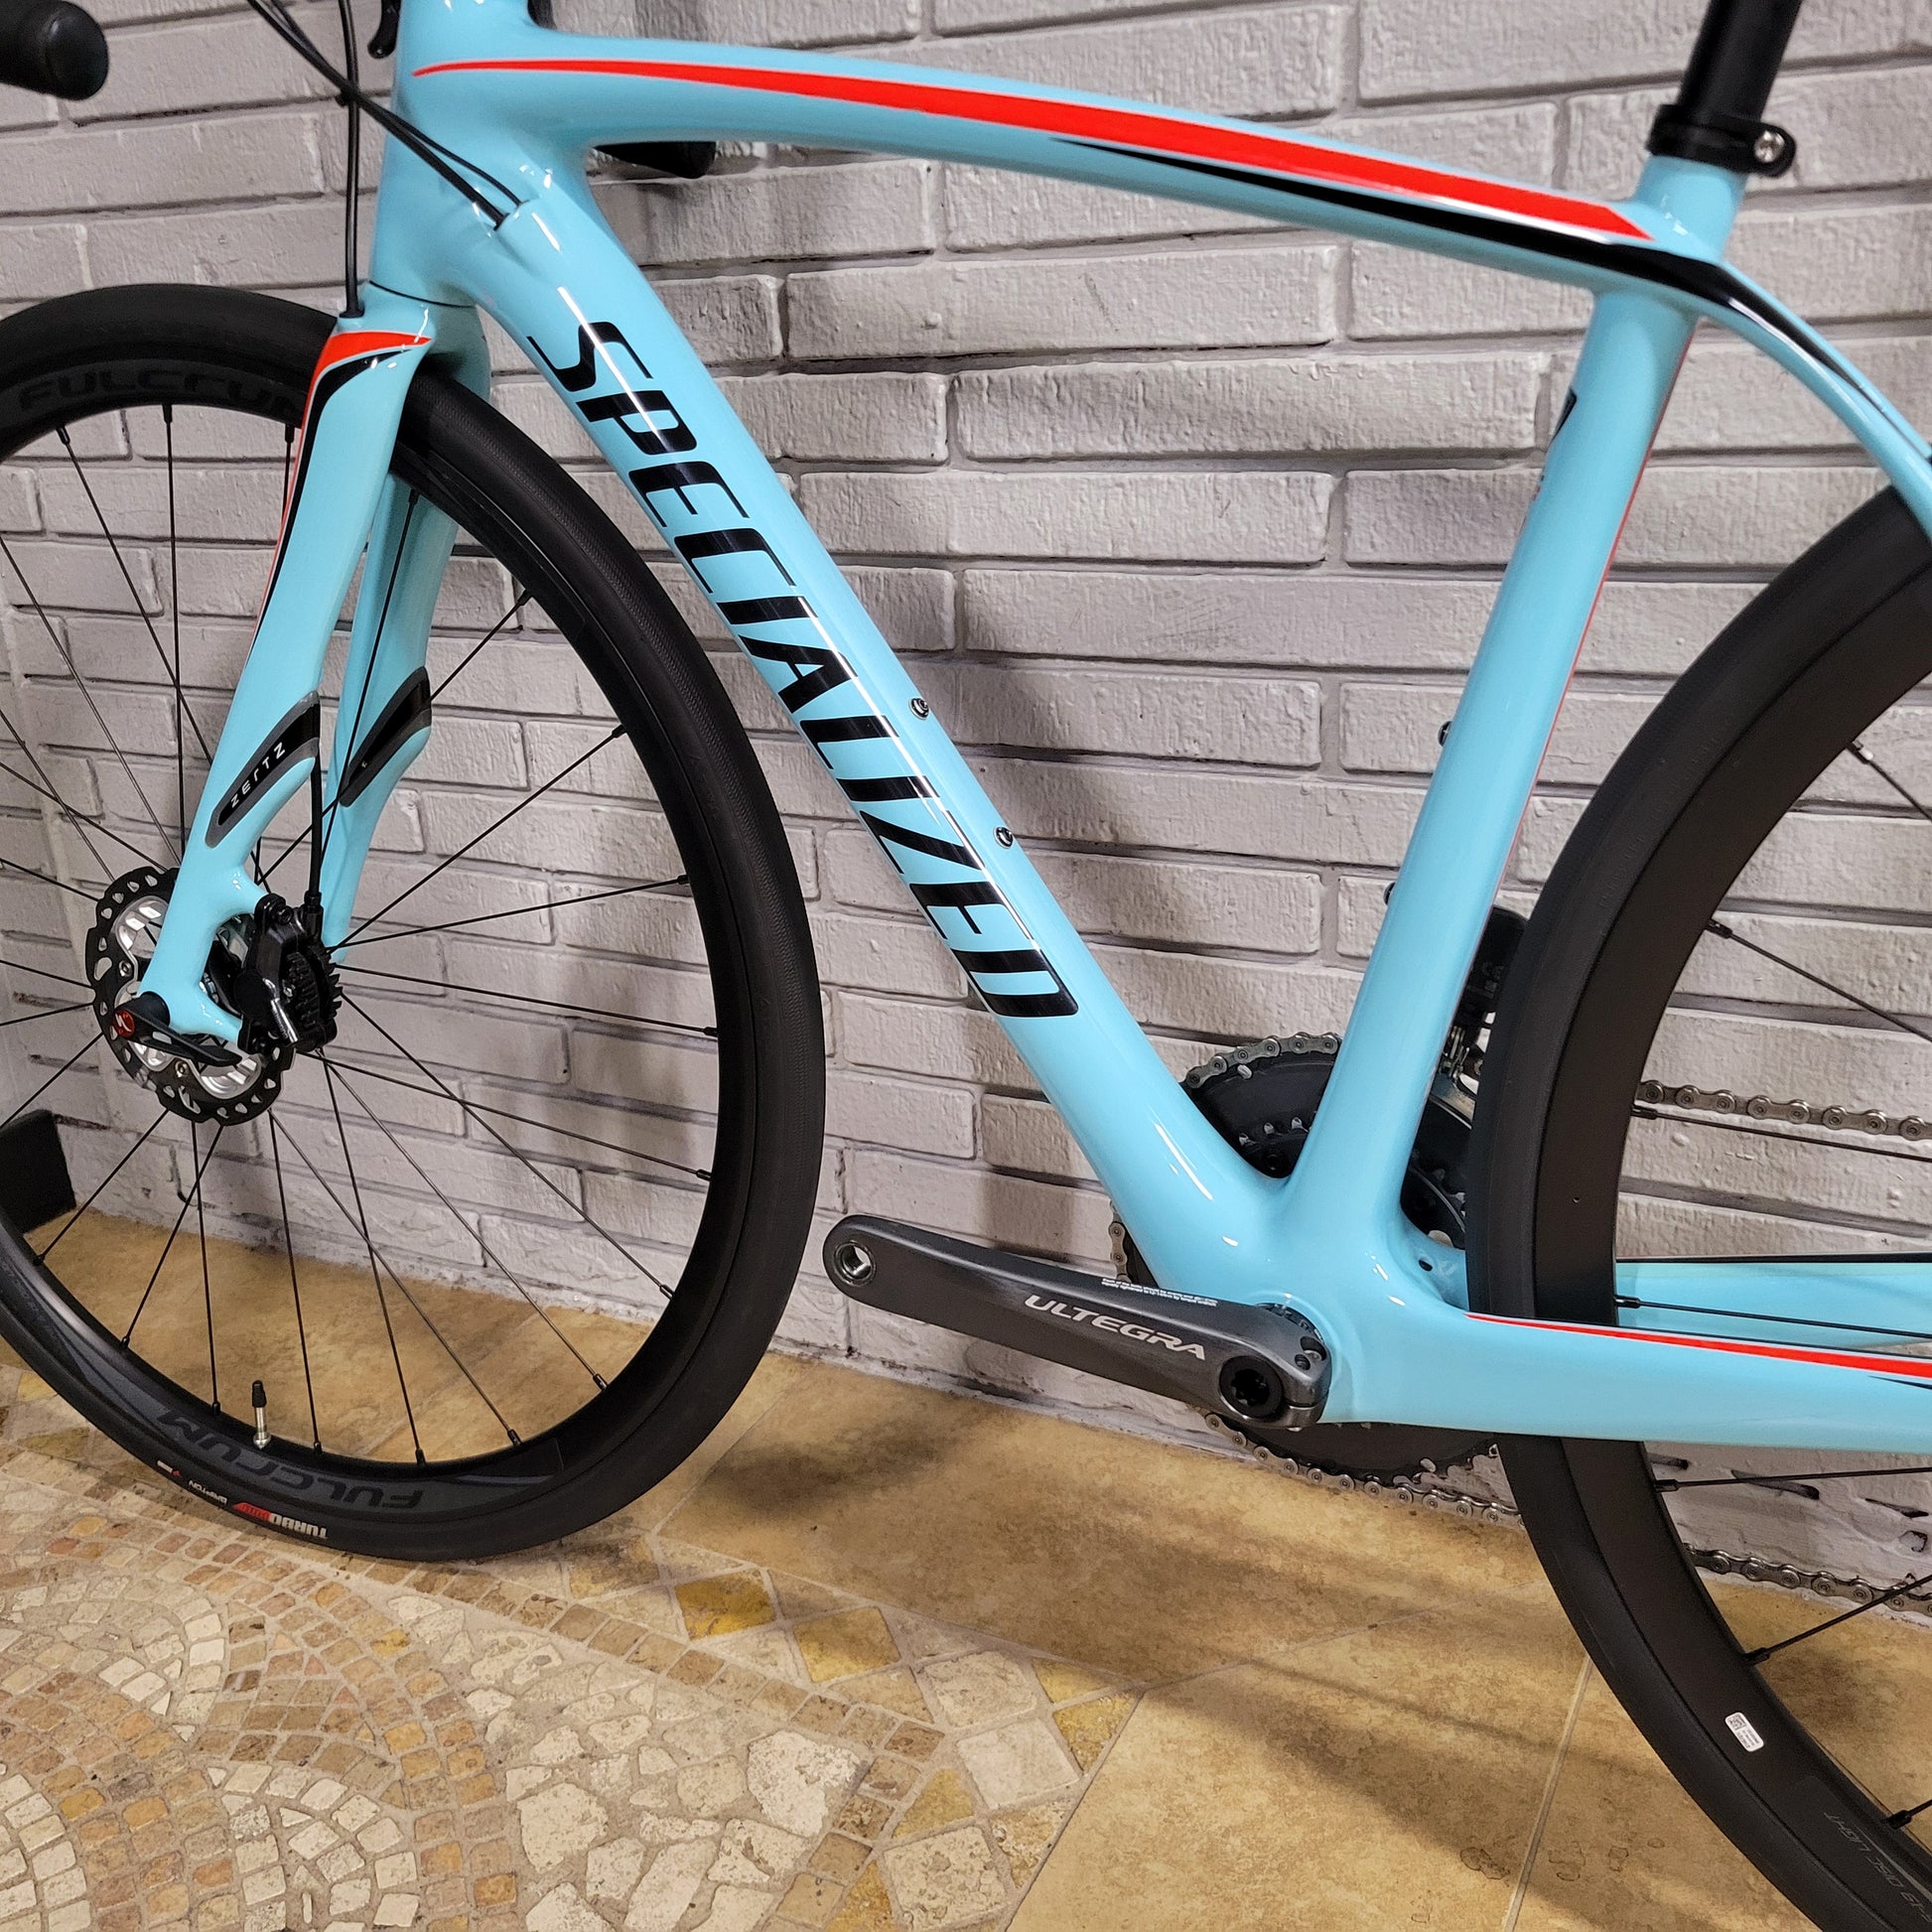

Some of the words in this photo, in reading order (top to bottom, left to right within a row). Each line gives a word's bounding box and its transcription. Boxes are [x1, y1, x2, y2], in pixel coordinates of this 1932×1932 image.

[527, 321, 1078, 1018] SPECIALIZED
[230, 742, 285, 809] ZERTZ
[1024, 1294, 1205, 1360] ULTEGRA
[157, 1410, 424, 1509] FULCRUM
[268, 1512, 328, 1539] TURBO
